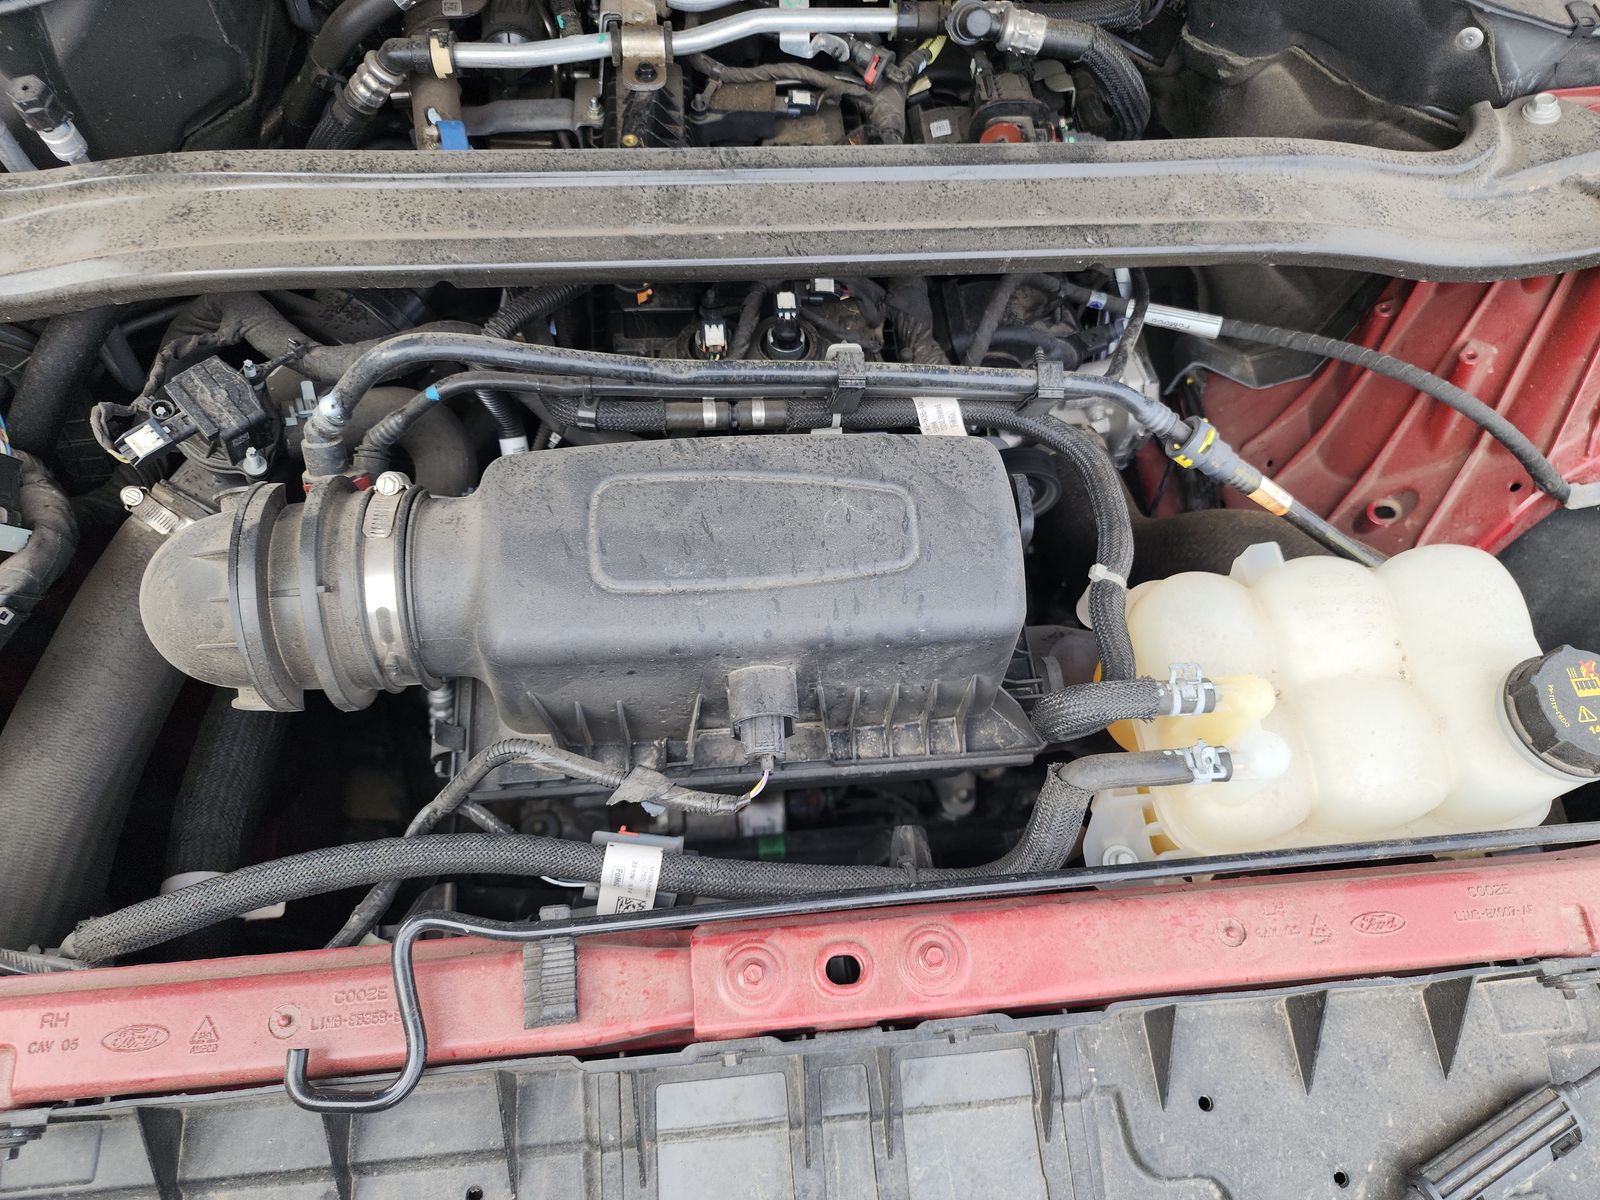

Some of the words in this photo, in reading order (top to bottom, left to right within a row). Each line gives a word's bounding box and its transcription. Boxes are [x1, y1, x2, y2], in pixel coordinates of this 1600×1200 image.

[1360, 913, 1397, 931] Ford
[40, 1012, 70, 1030] RH
[27, 1039, 56, 1055] CAV
[61, 1037, 80, 1052] 05
[112, 1027, 161, 1049] Ford
